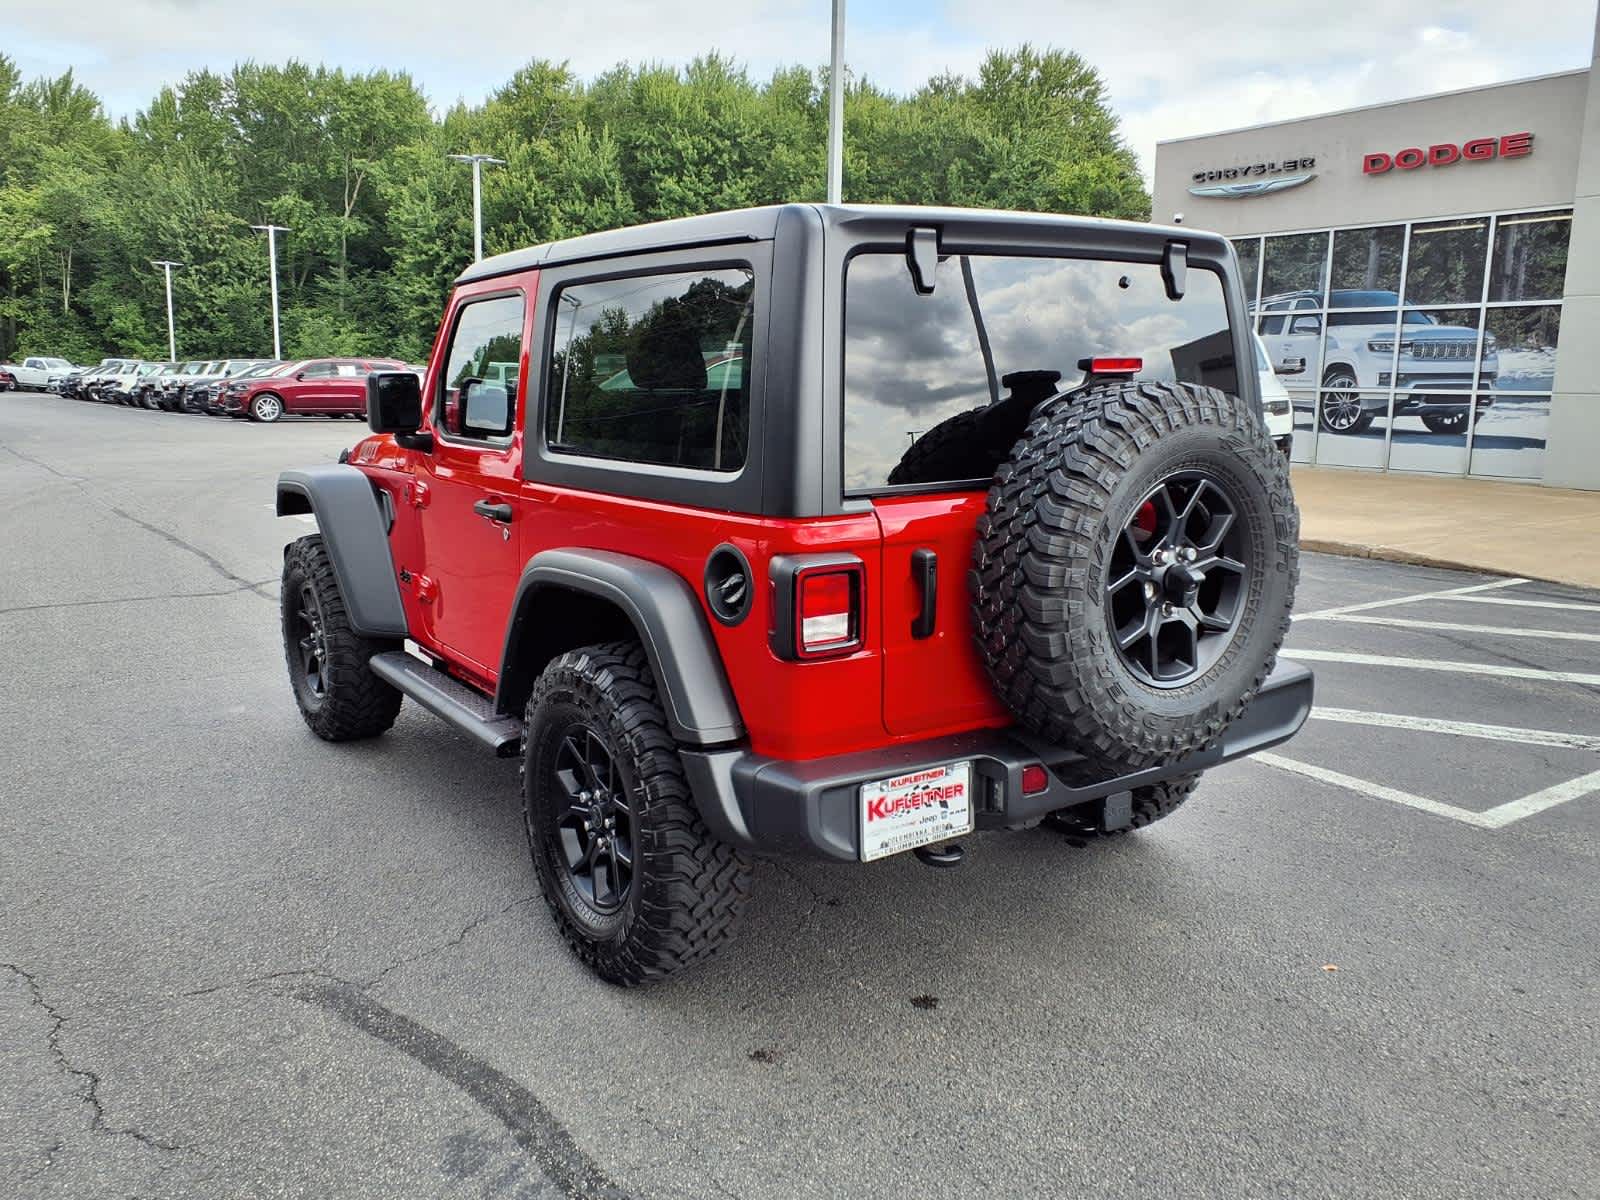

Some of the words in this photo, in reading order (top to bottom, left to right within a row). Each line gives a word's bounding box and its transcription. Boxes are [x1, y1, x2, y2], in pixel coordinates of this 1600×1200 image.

[1362, 132, 1534, 176] DODGE
[1192, 158, 1316, 183] CHRYSLER
[890, 769, 945, 788] KUFLEITNER
[919, 814, 938, 825] Jeep
